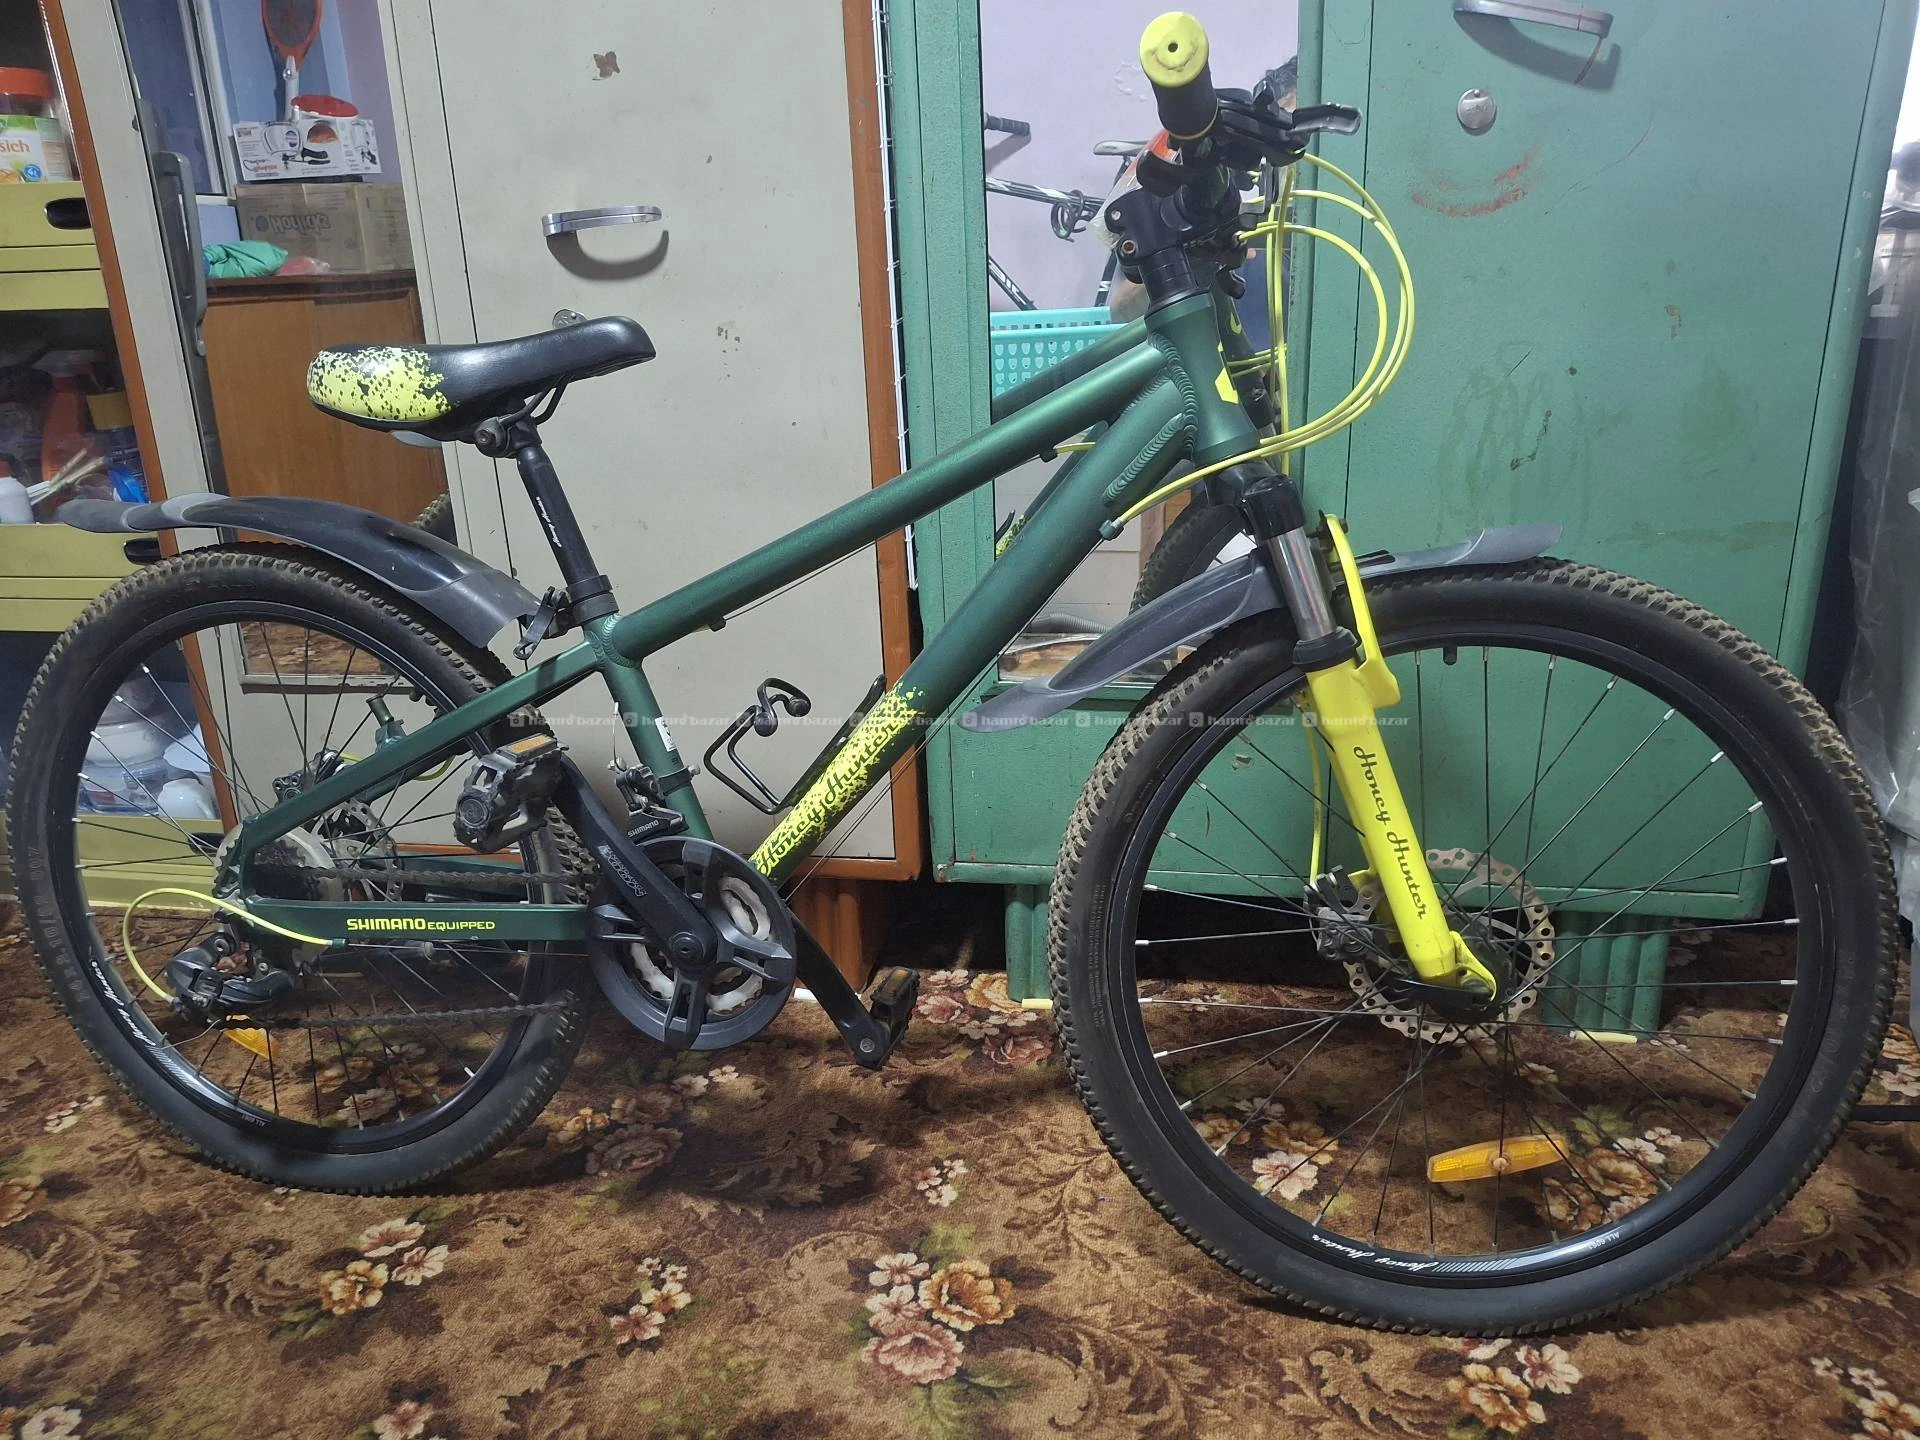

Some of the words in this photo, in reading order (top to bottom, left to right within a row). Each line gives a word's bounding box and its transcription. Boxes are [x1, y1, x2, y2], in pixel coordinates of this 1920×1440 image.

[627, 819, 660, 838] SHIMANO
[1386, 831, 1428, 920] Hunter
[346, 918, 426, 931] SHIMANO
[427, 921, 496, 932] EQUIPPED
